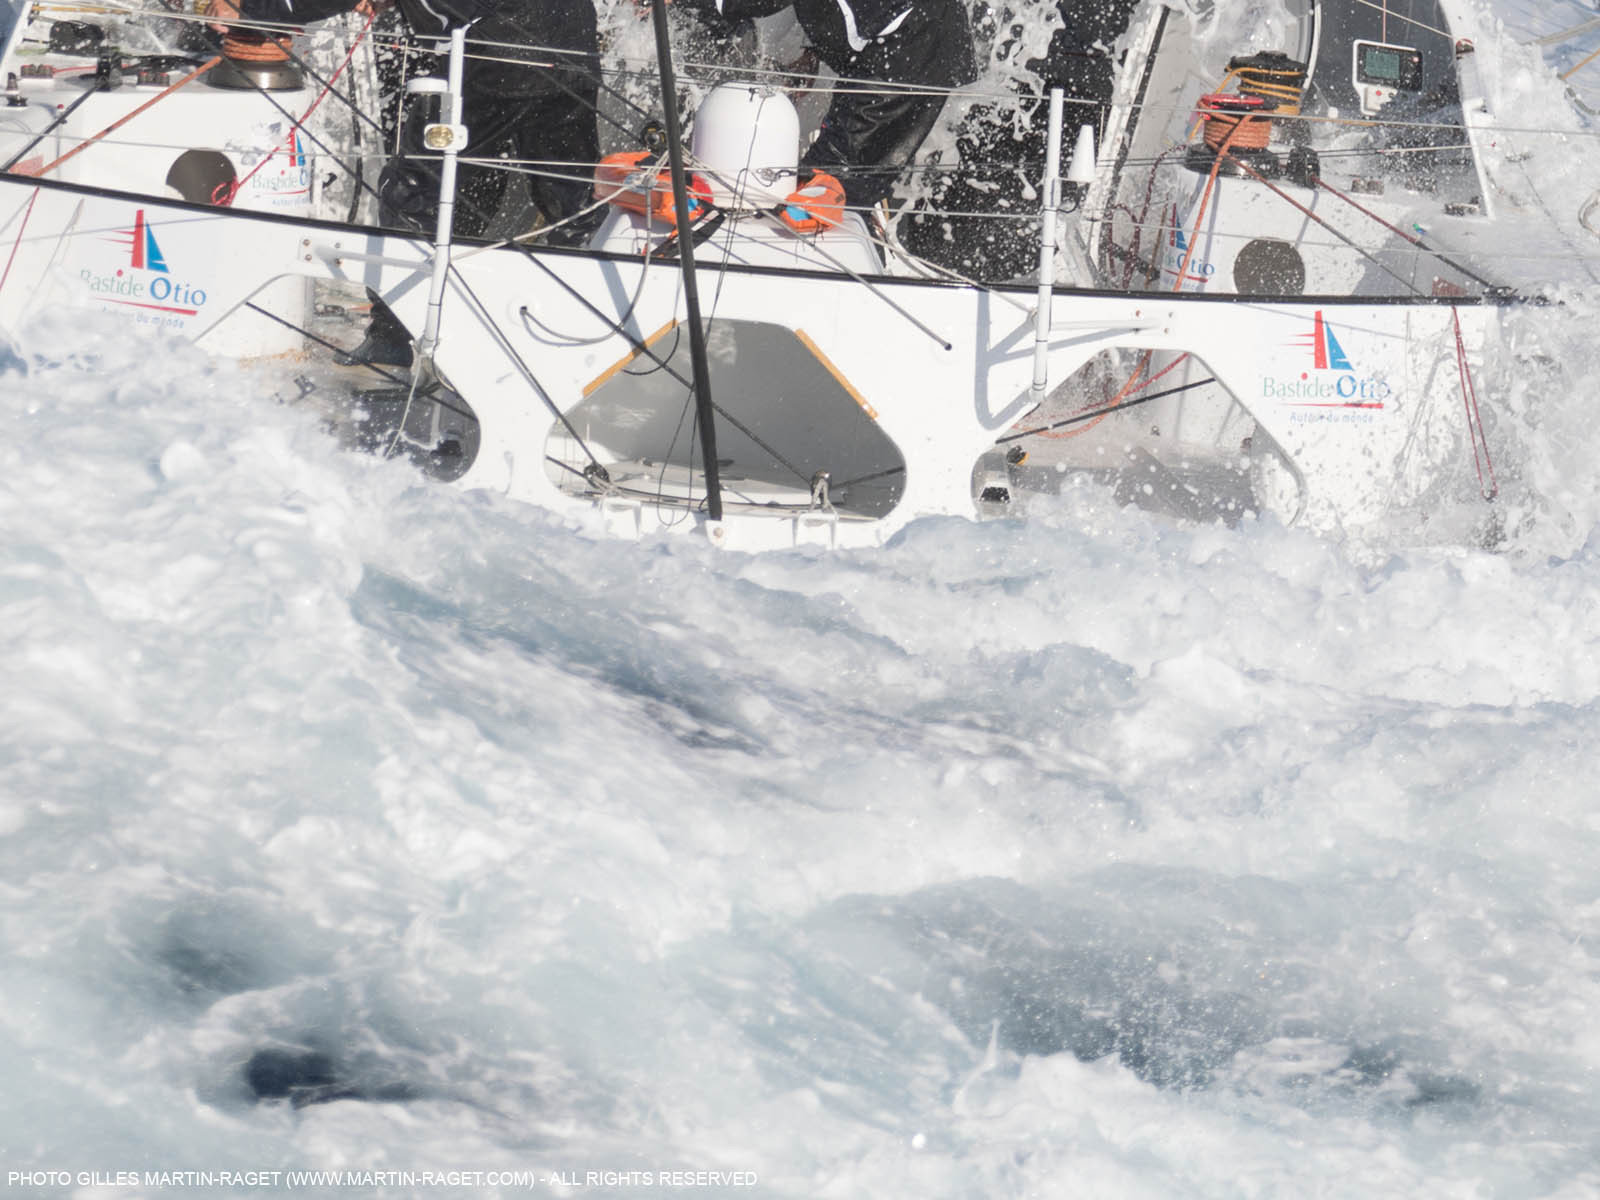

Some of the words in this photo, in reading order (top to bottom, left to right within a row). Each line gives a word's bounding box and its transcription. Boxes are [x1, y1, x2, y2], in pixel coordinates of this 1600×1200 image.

[150, 277, 207, 306] Otio
[1263, 372, 1330, 398] Bastide
[1336, 375, 1391, 400] Otio
